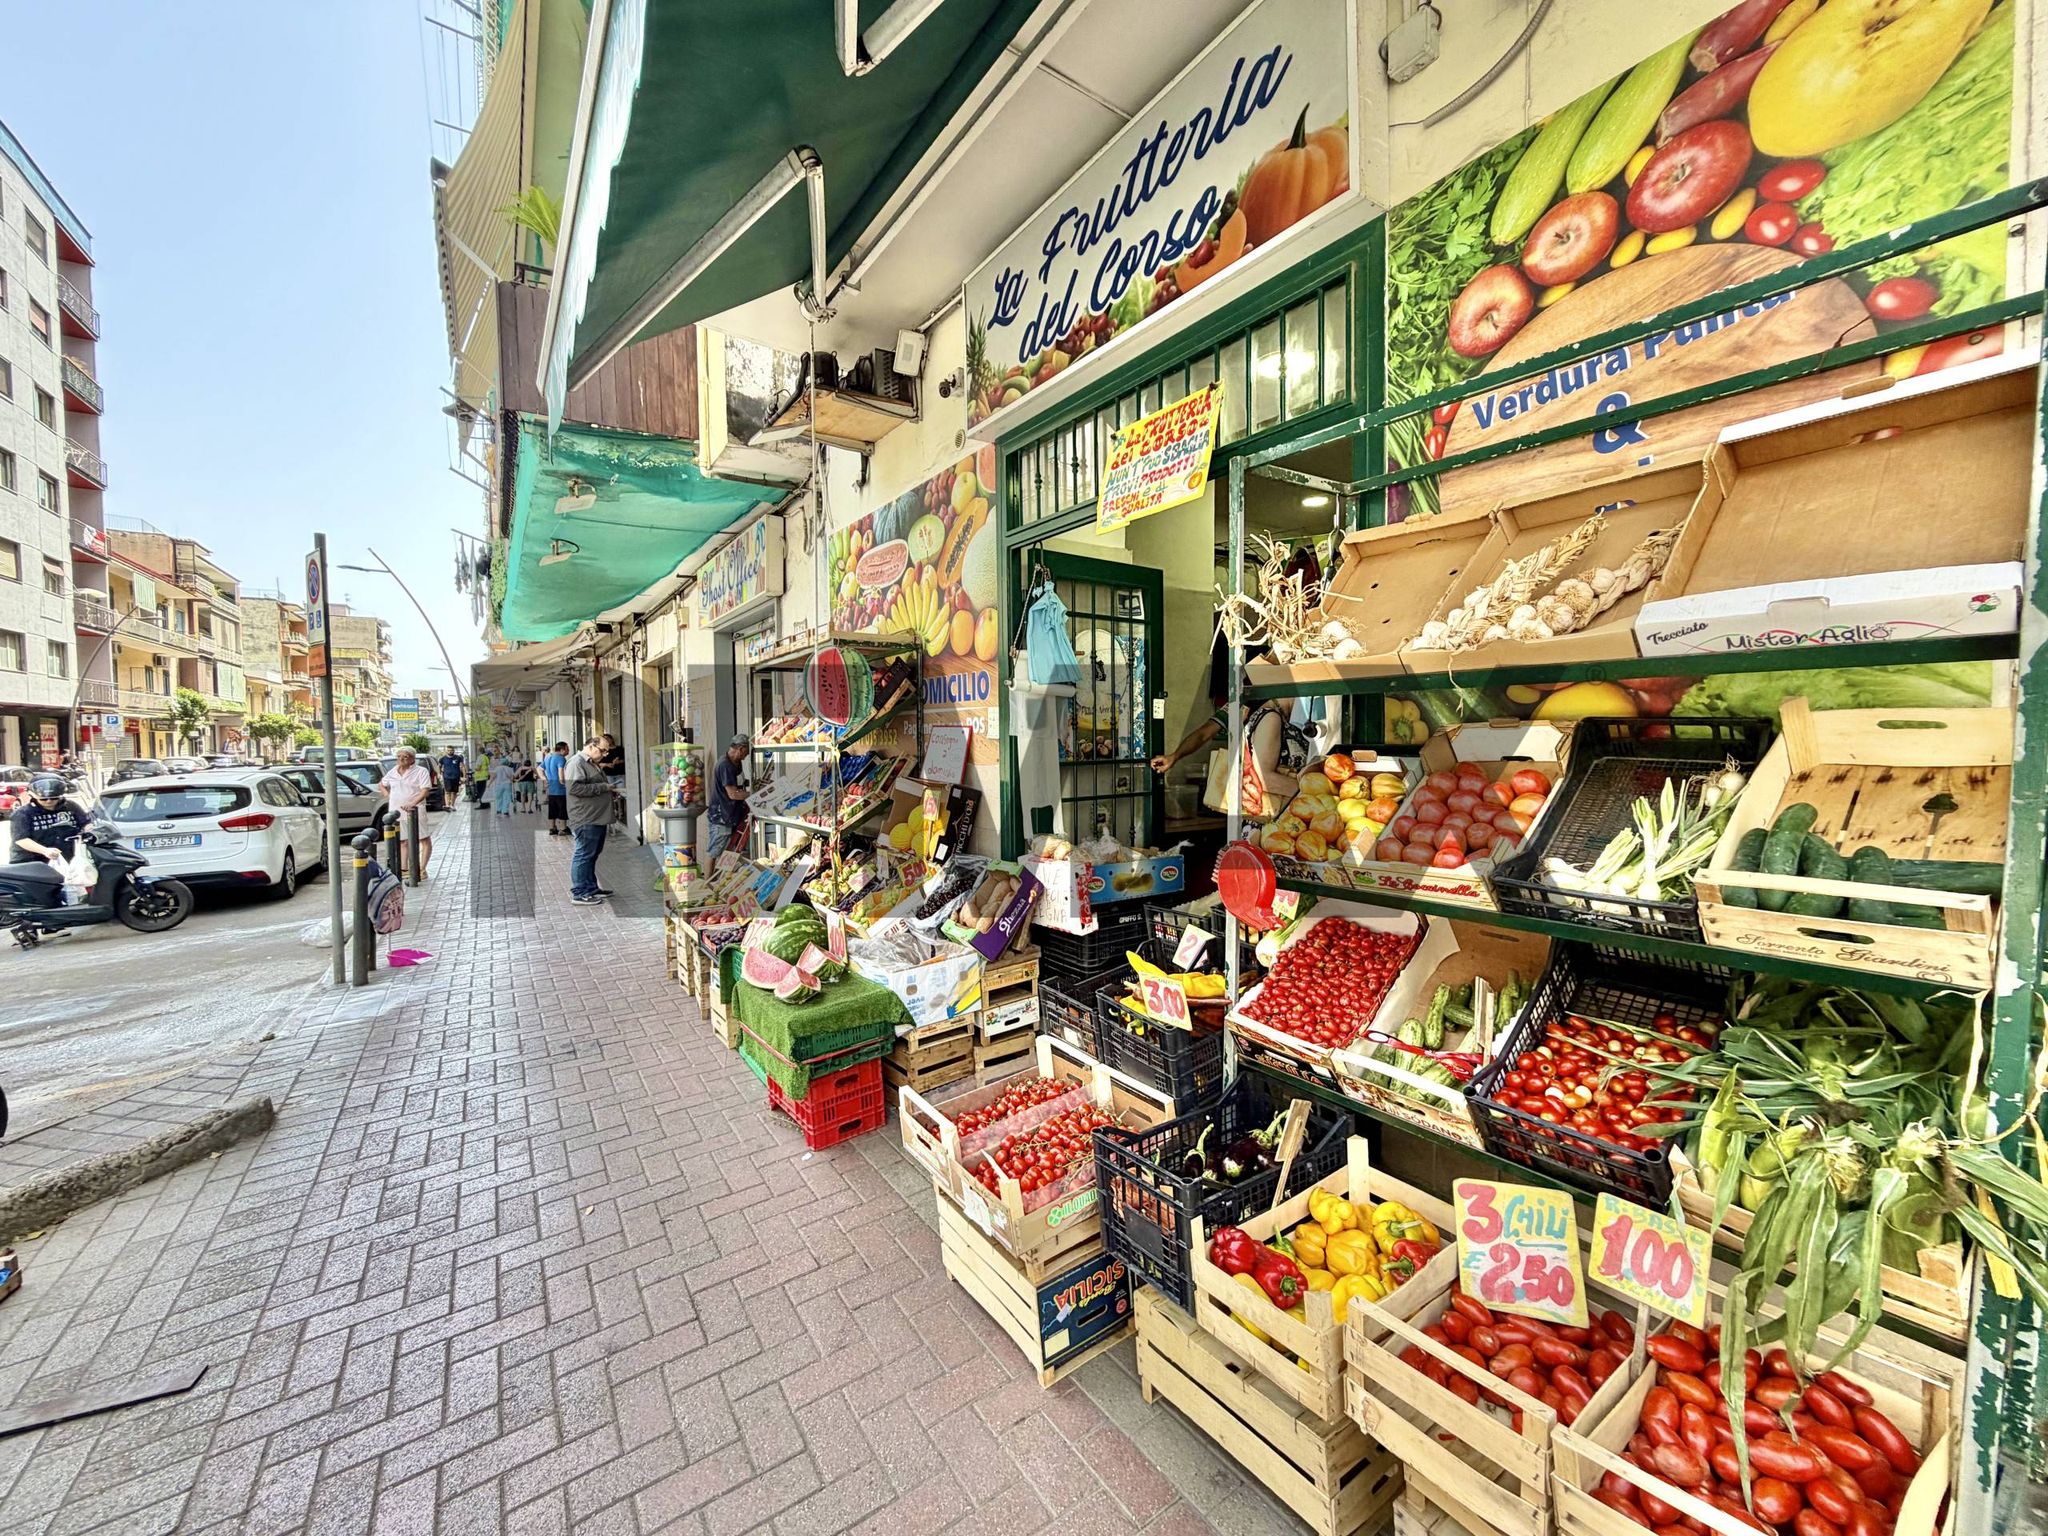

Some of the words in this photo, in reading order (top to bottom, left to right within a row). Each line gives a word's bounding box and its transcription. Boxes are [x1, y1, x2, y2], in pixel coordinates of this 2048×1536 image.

[988, 267, 1028, 330] La
[1039, 45, 1293, 282] Frutteria
[1019, 270, 1080, 363] del
[1092, 186, 1221, 312] Corso
[1471, 346, 1631, 430] Verdura
[1592, 391, 1650, 455] &
[1646, 621, 1709, 646] Trecciato
[1726, 629, 1810, 651] Mister
[921, 669, 990, 704] OMICILIO
[1736, 933, 1825, 955] Sorrento
[1835, 945, 1951, 972] Giardini
[1458, 1183, 1504, 1244] 3
[1054, 1260, 1125, 1312] SICILIA
